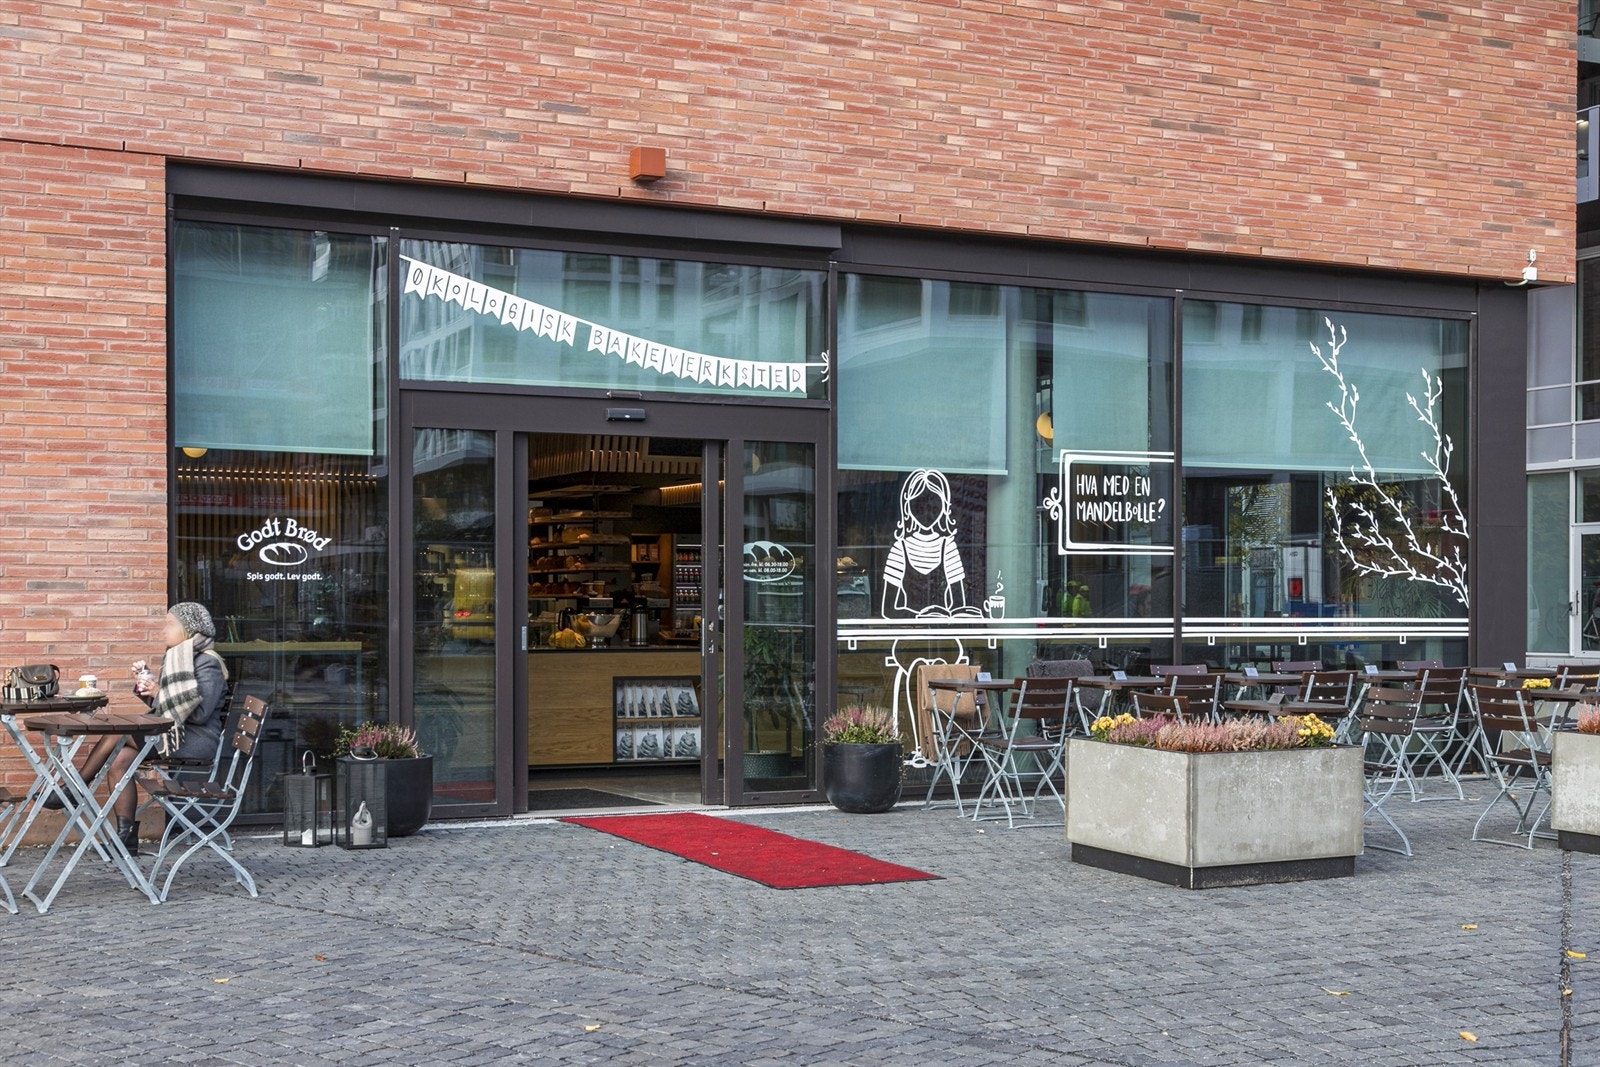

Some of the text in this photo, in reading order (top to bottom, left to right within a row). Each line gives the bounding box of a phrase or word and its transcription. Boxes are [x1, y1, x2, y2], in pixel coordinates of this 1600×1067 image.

[412, 267, 802, 383] ØKOLOGISK BAKEVERKSTED
[1076, 474, 1151, 497] HVA MED EN
[1076, 498, 1166, 523] MANDELBOLLE?
[237, 517, 332, 551] Godt Brød
[246, 572, 323, 582] Spis godt. Lev godt.
